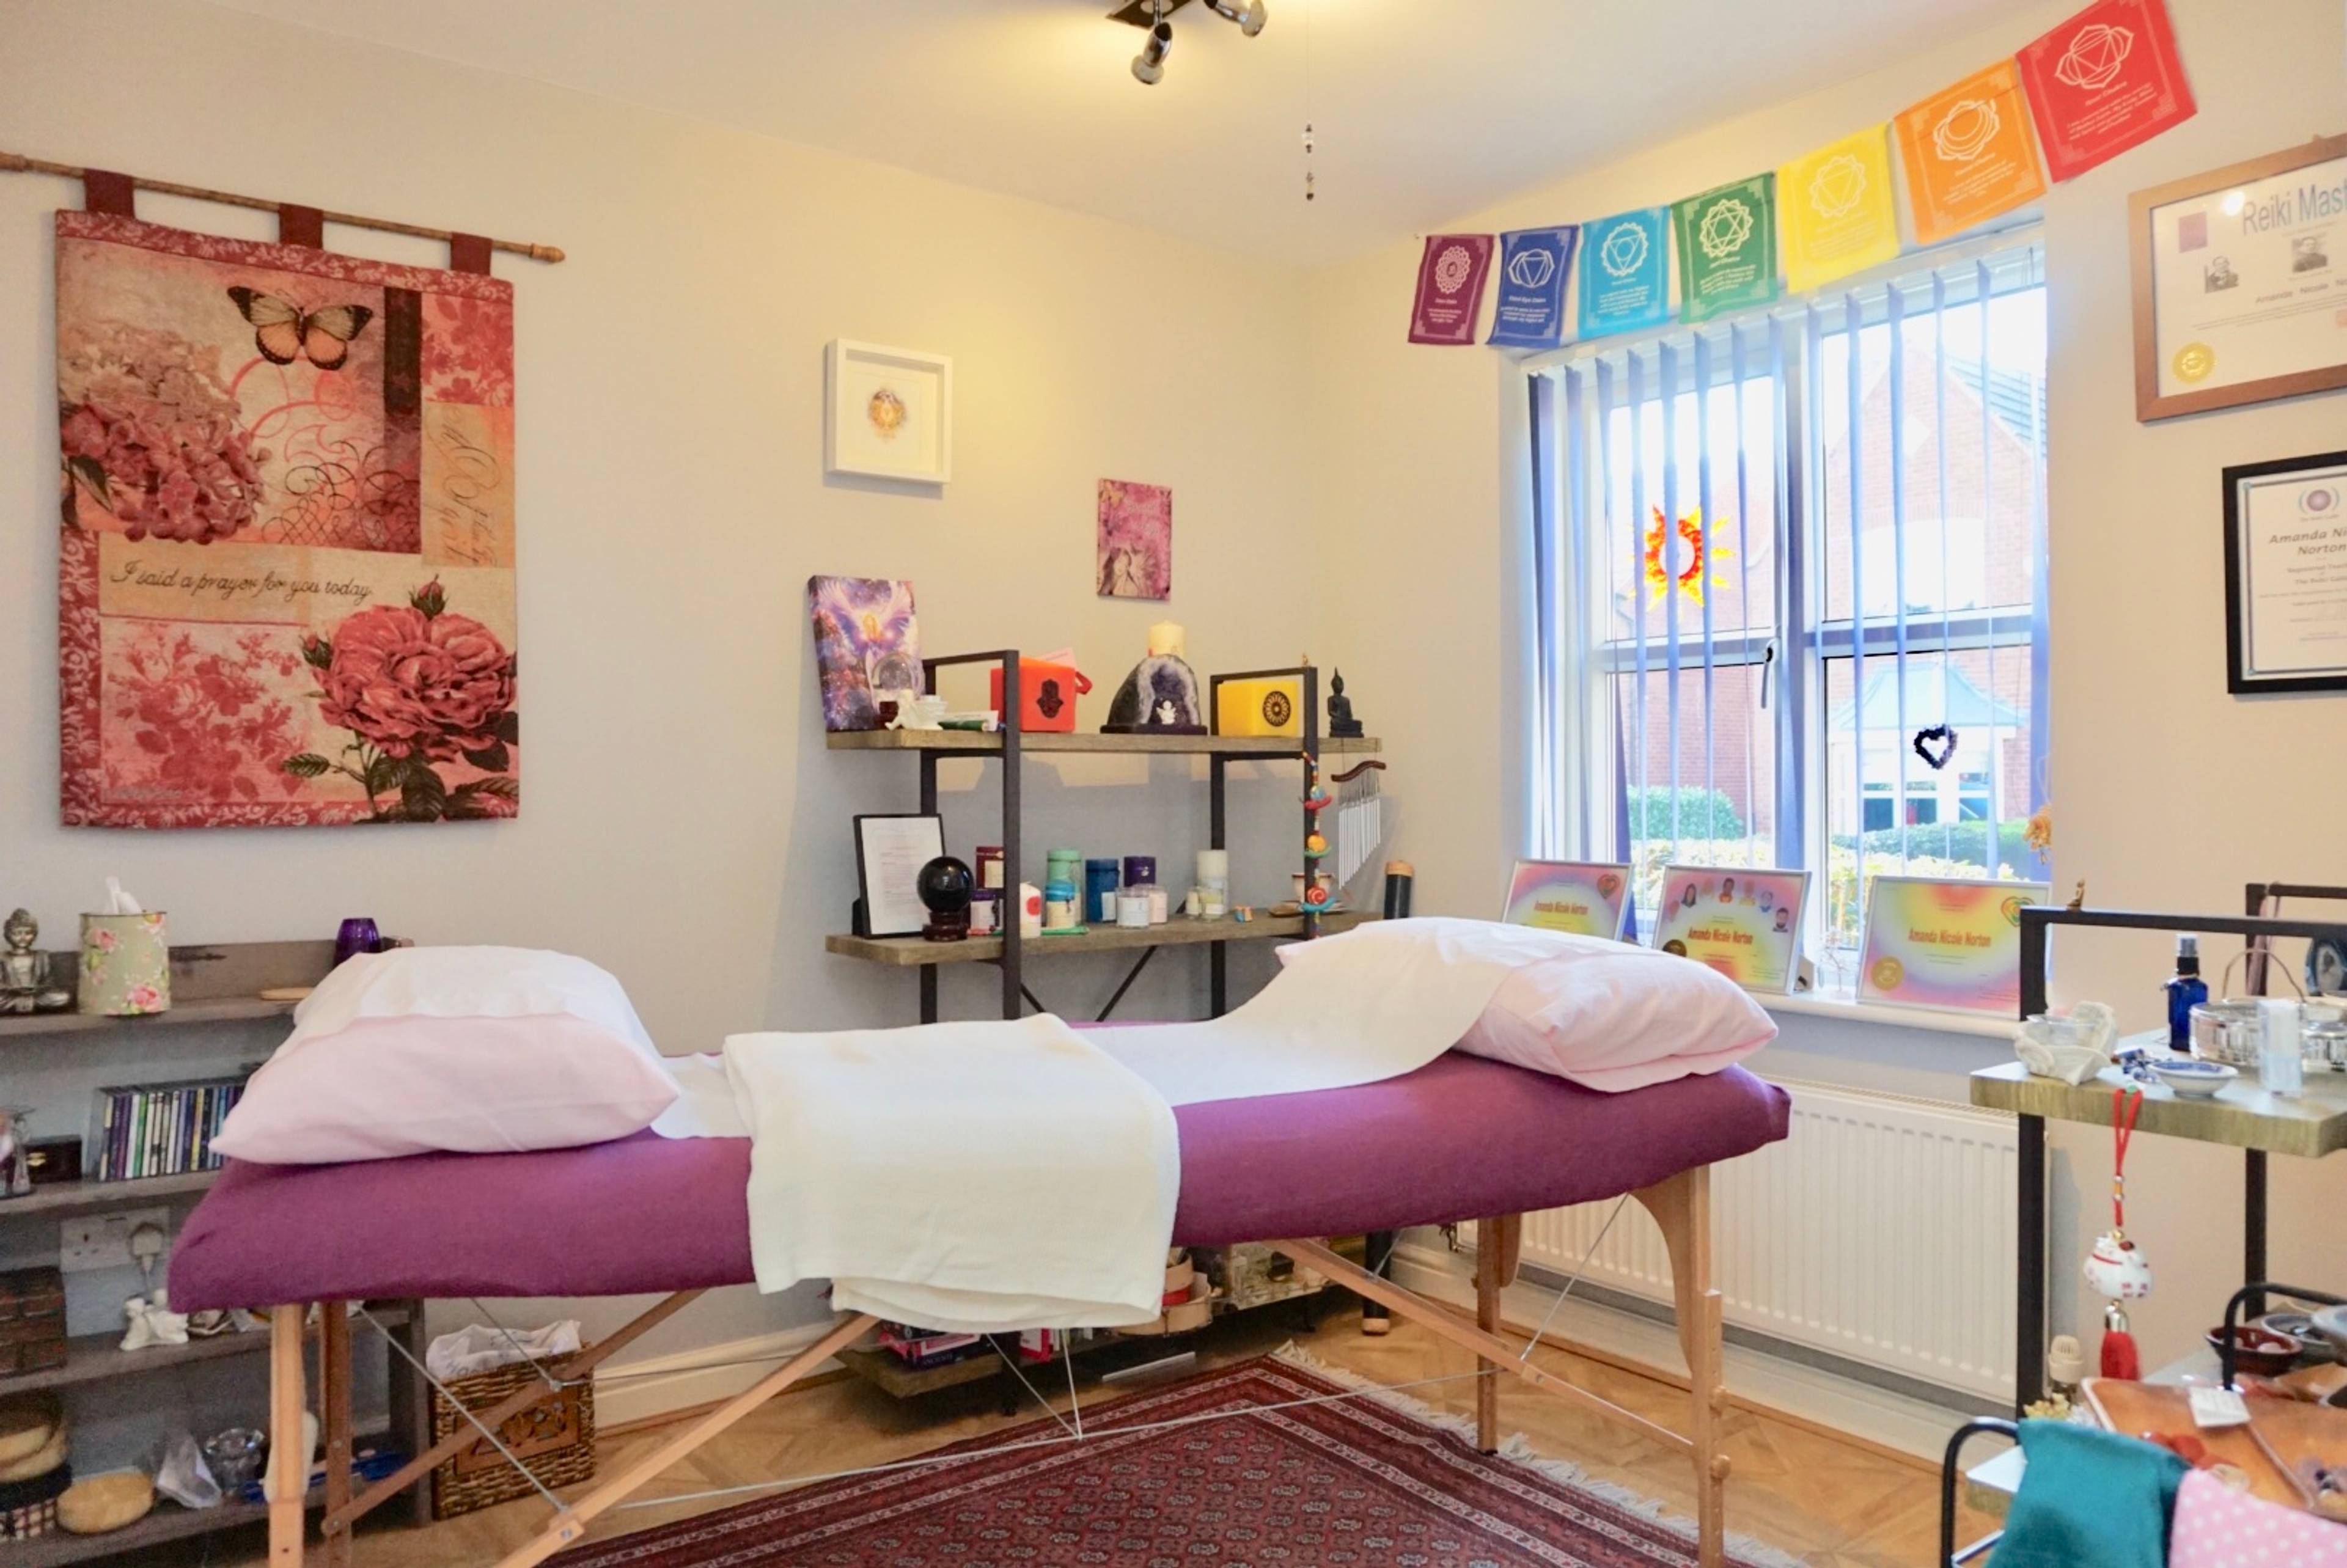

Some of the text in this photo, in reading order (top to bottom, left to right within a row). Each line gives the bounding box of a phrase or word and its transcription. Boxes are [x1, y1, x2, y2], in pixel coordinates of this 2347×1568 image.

[2242, 190, 2292, 236] Reiki
[2268, 529, 2327, 544] Amanda
[2297, 544, 2346, 555] Norton
[109, 559, 373, 606] I said a prayer for you today
[1733, 930, 1753, 945] Norton
[1908, 927, 1937, 943] Amanda
[1964, 931, 1992, 948] Norton
